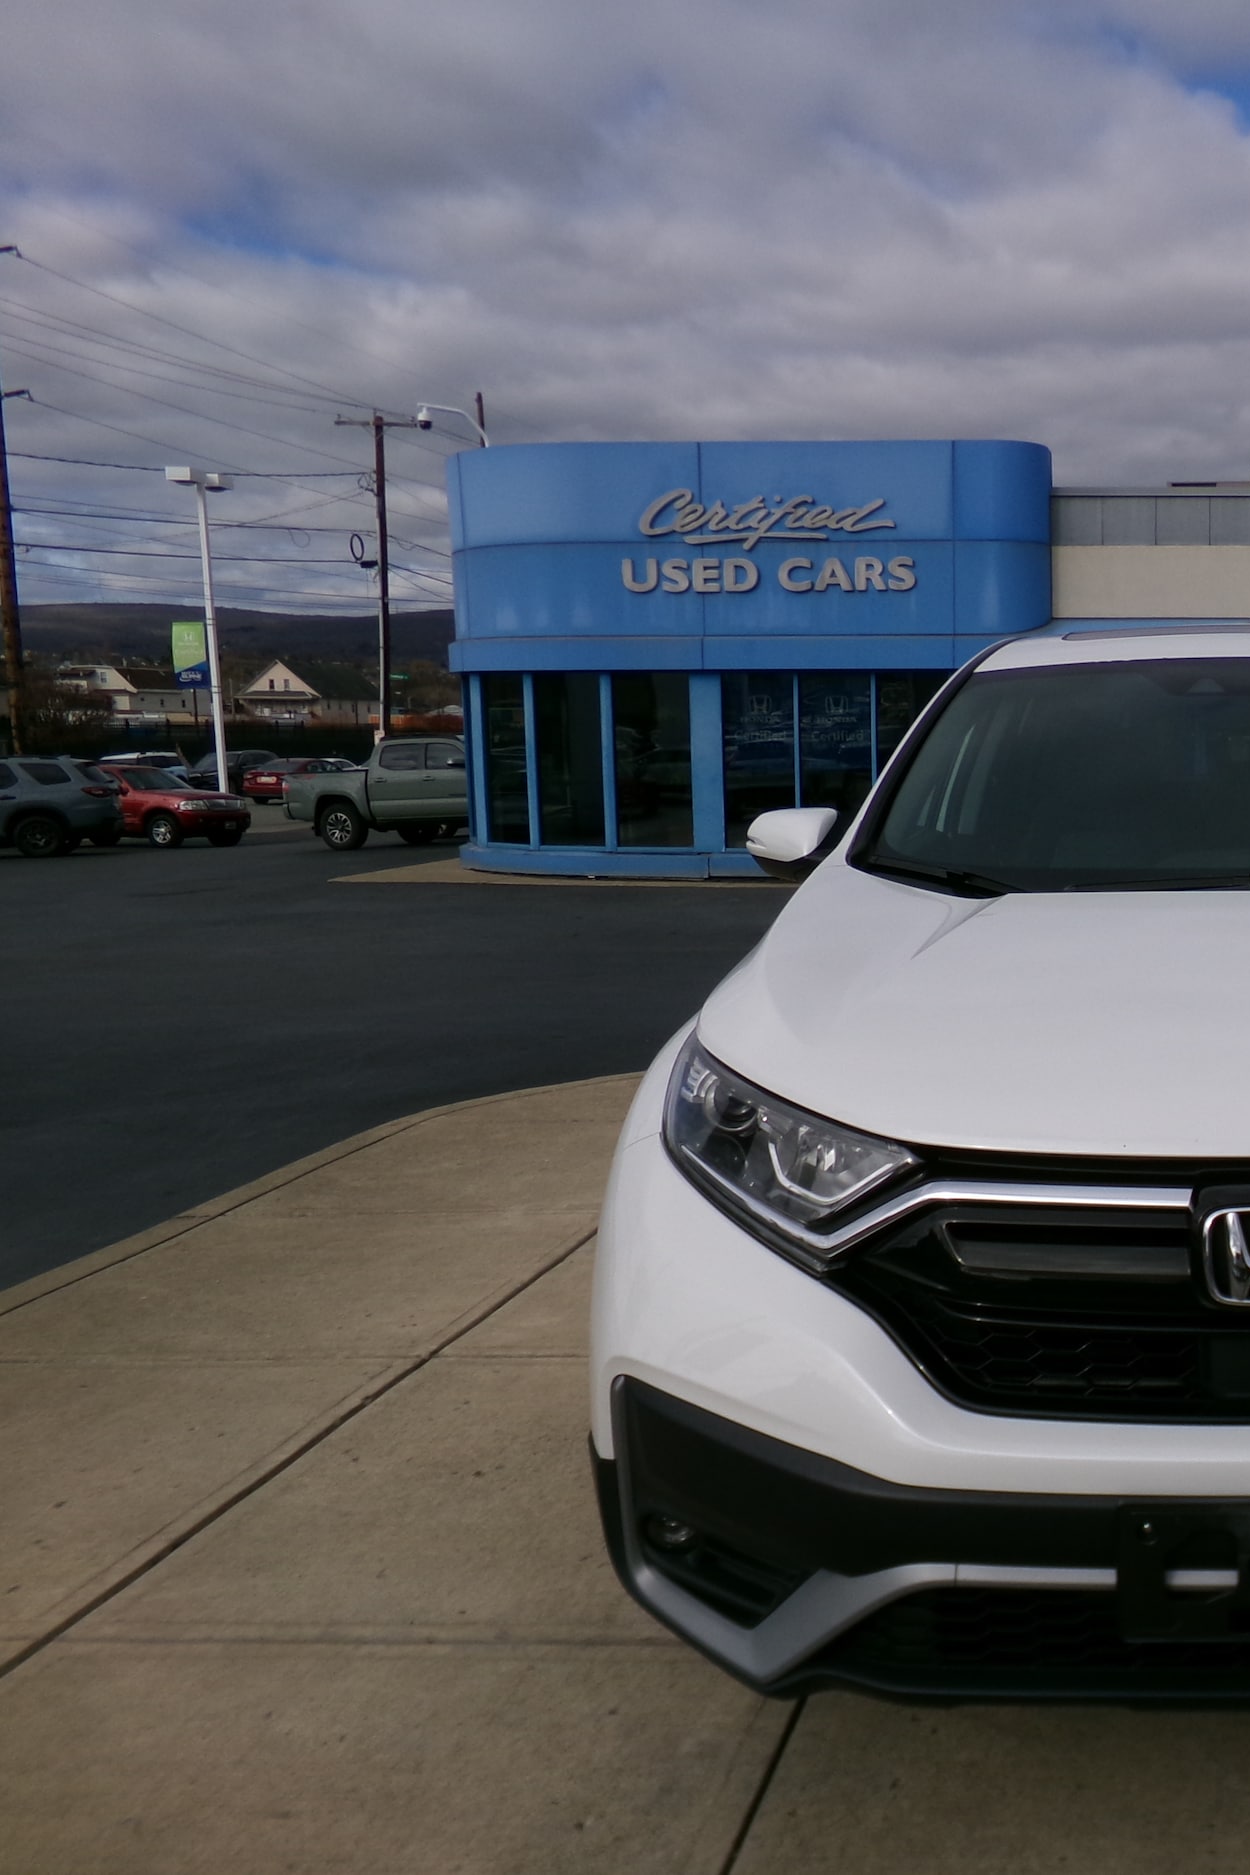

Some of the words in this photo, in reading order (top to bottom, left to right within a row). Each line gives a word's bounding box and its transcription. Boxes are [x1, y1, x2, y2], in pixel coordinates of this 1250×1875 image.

[638, 487, 895, 550] Certified
[621, 557, 758, 594] USED
[778, 556, 917, 593] CARS
